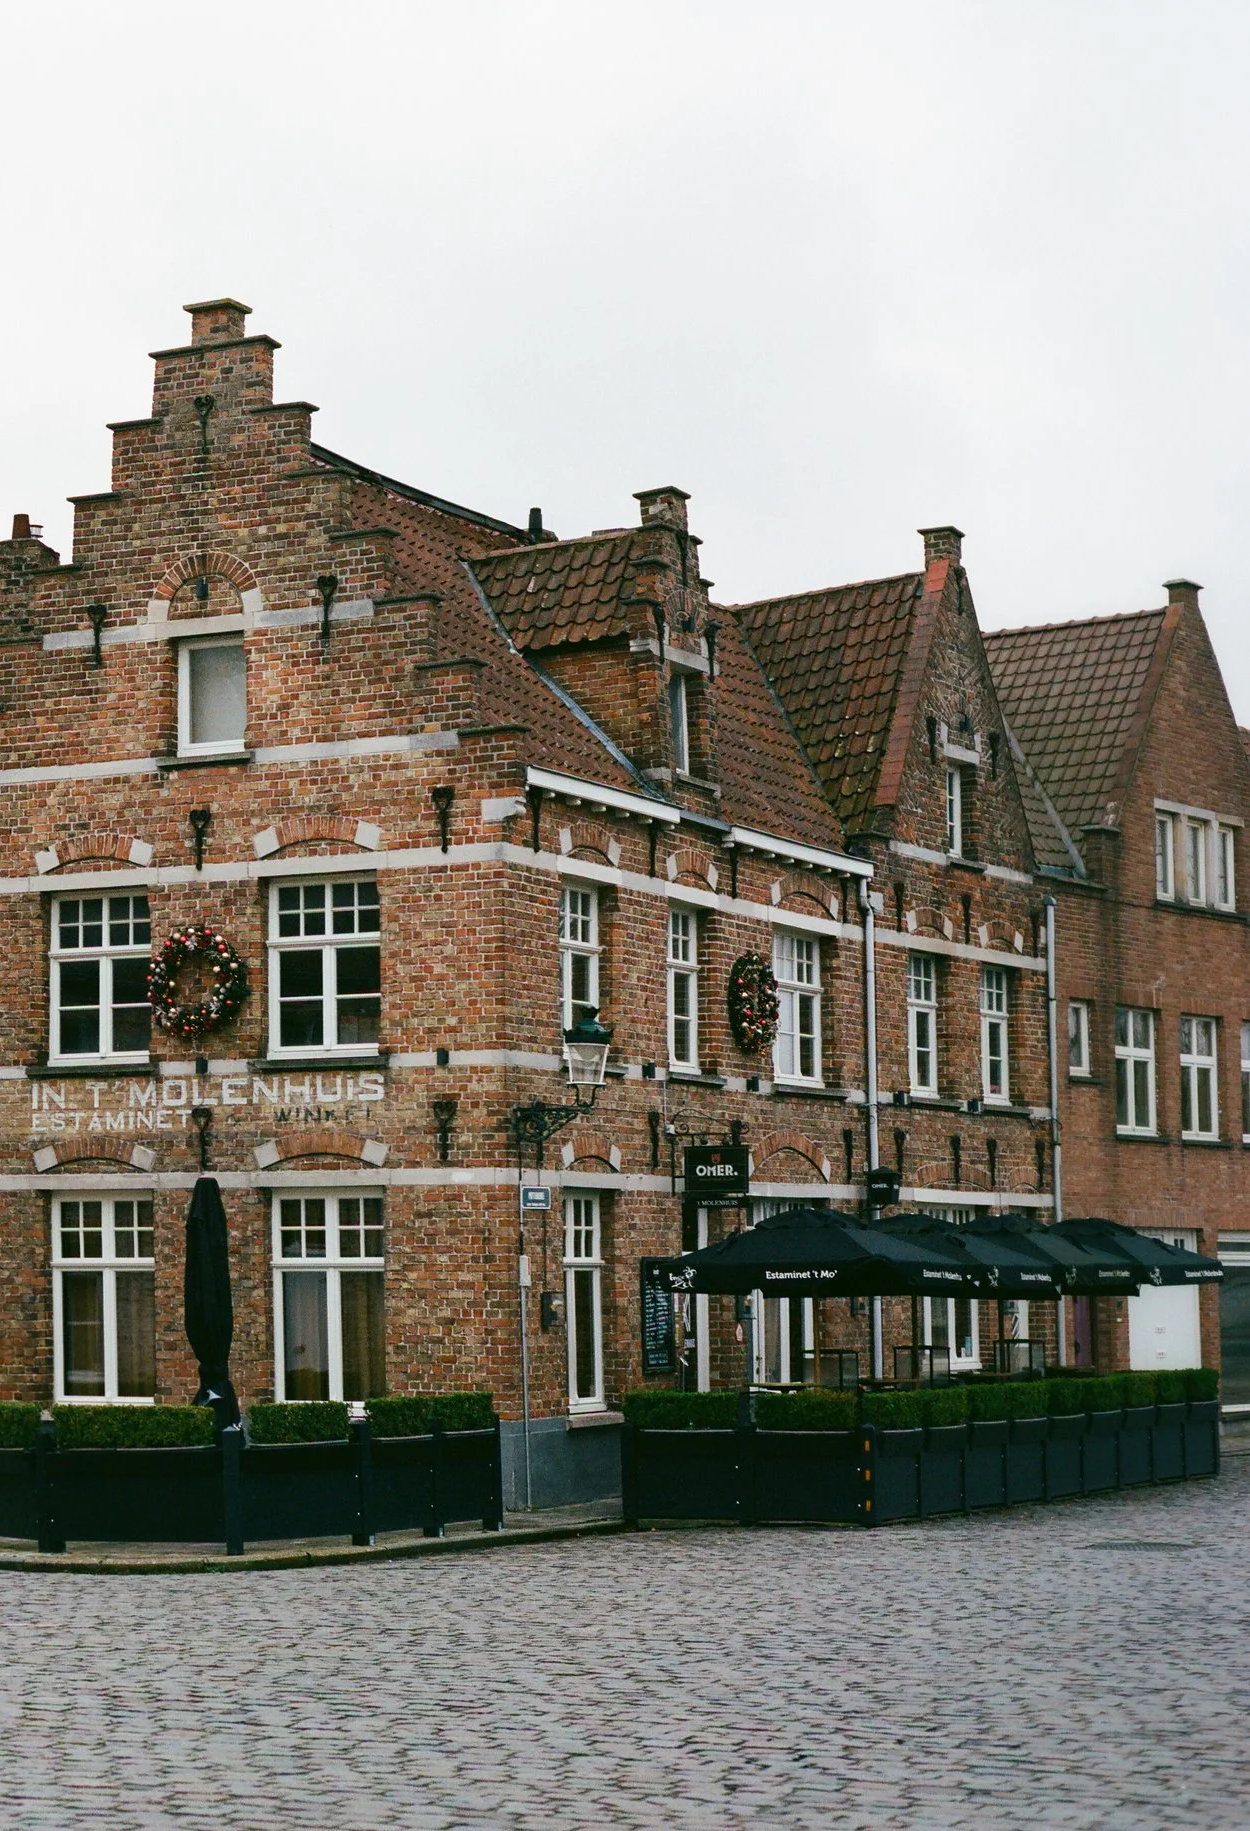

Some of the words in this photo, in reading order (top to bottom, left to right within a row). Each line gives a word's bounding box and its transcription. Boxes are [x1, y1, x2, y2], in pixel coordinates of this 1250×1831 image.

[31, 1082, 66, 1110] IN
[30, 1110, 192, 1133] ESTAMINET
[765, 1270, 811, 1279] Estaminet
